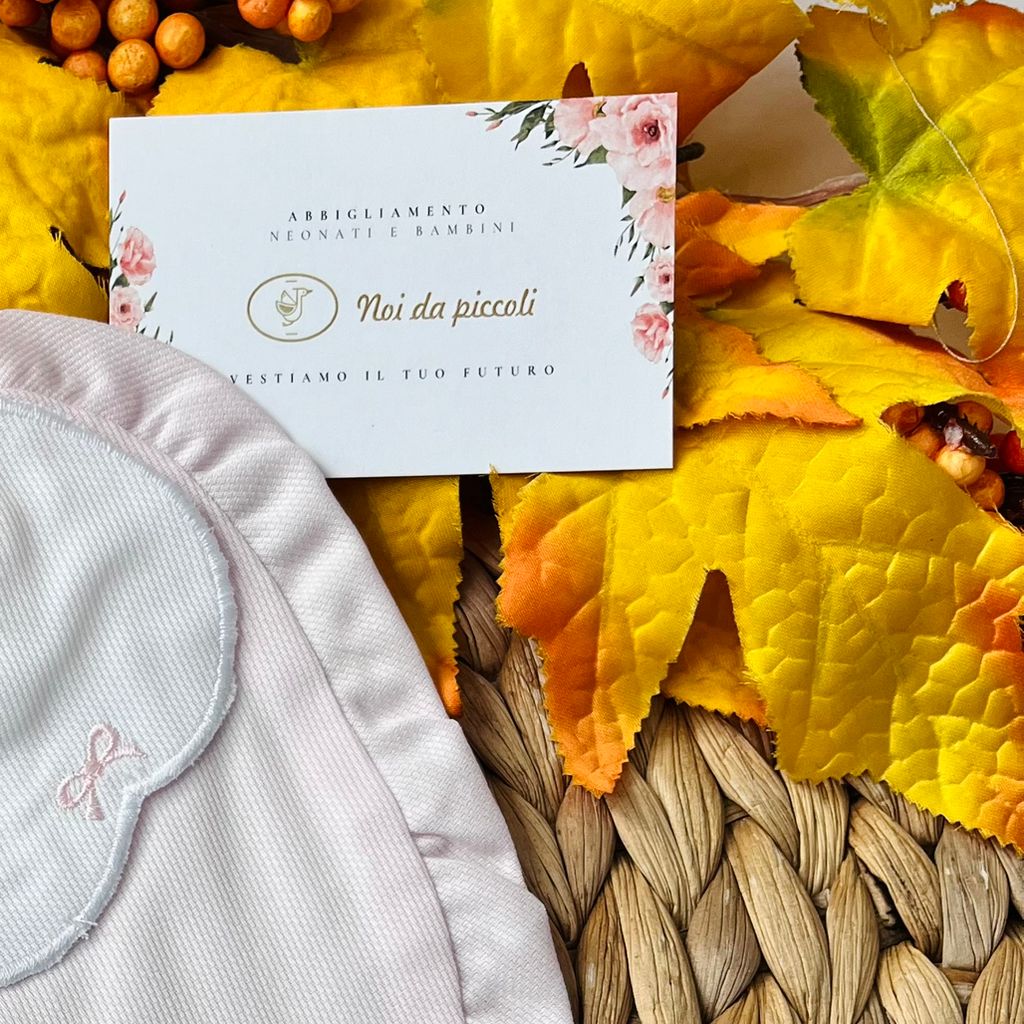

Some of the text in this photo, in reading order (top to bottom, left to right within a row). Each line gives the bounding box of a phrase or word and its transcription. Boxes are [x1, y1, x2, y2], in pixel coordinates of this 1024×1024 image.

[288, 203, 485, 222] ABBIGLIAMENTO
[270, 221, 514, 242] NEONATI E BAMBINI
[357, 288, 537, 327] Noi da piccoli
[230, 364, 554, 384] VESTIAMO IL TUO FUTURO
